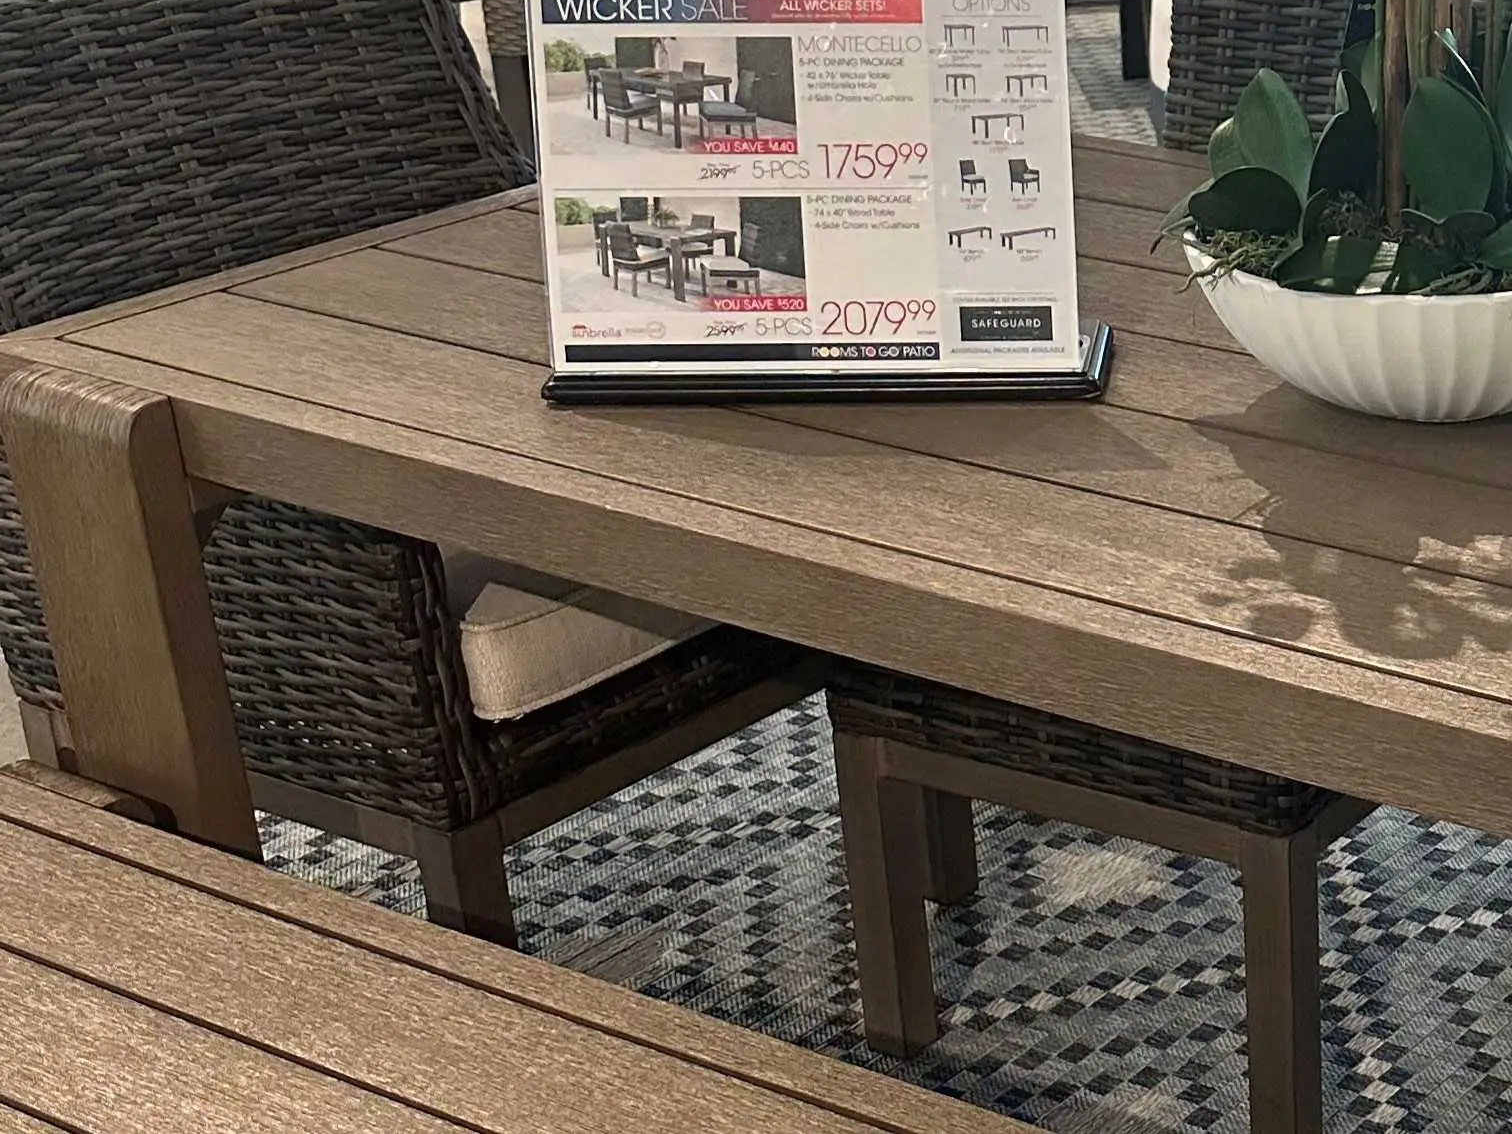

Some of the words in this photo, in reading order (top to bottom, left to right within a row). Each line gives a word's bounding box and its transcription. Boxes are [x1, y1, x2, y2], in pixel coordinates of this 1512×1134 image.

[780, 0, 801, 11] ALL
[804, 0, 852, 11] WICKER
[856, 0, 886, 11] SETS!
[798, 35, 922, 53] MONTECELLO
[799, 57, 820, 66] 5-PC
[824, 57, 858, 66] DINING
[860, 57, 904, 66] PACKAGE
[704, 141, 730, 153] YOU
[733, 141, 765, 153] SAVE
[768, 140, 794, 153] $440
[752, 160, 810, 179] 5-PCS
[806, 195, 829, 204] 5-PC
[831, 195, 865, 204] DINING
[867, 194, 912, 204] PACKAGE
[714, 299, 739, 310] YOU
[743, 299, 774, 310] SAVE
[777, 298, 804, 310] $520
[755, 317, 812, 336] 5-PCS
[971, 319, 1041, 328] SAFEGUARD
[811, 346, 858, 358] ROOMS
[860, 346, 876, 357] TO
[878, 346, 899, 357] GO
[903, 345, 935, 357] PATIO
